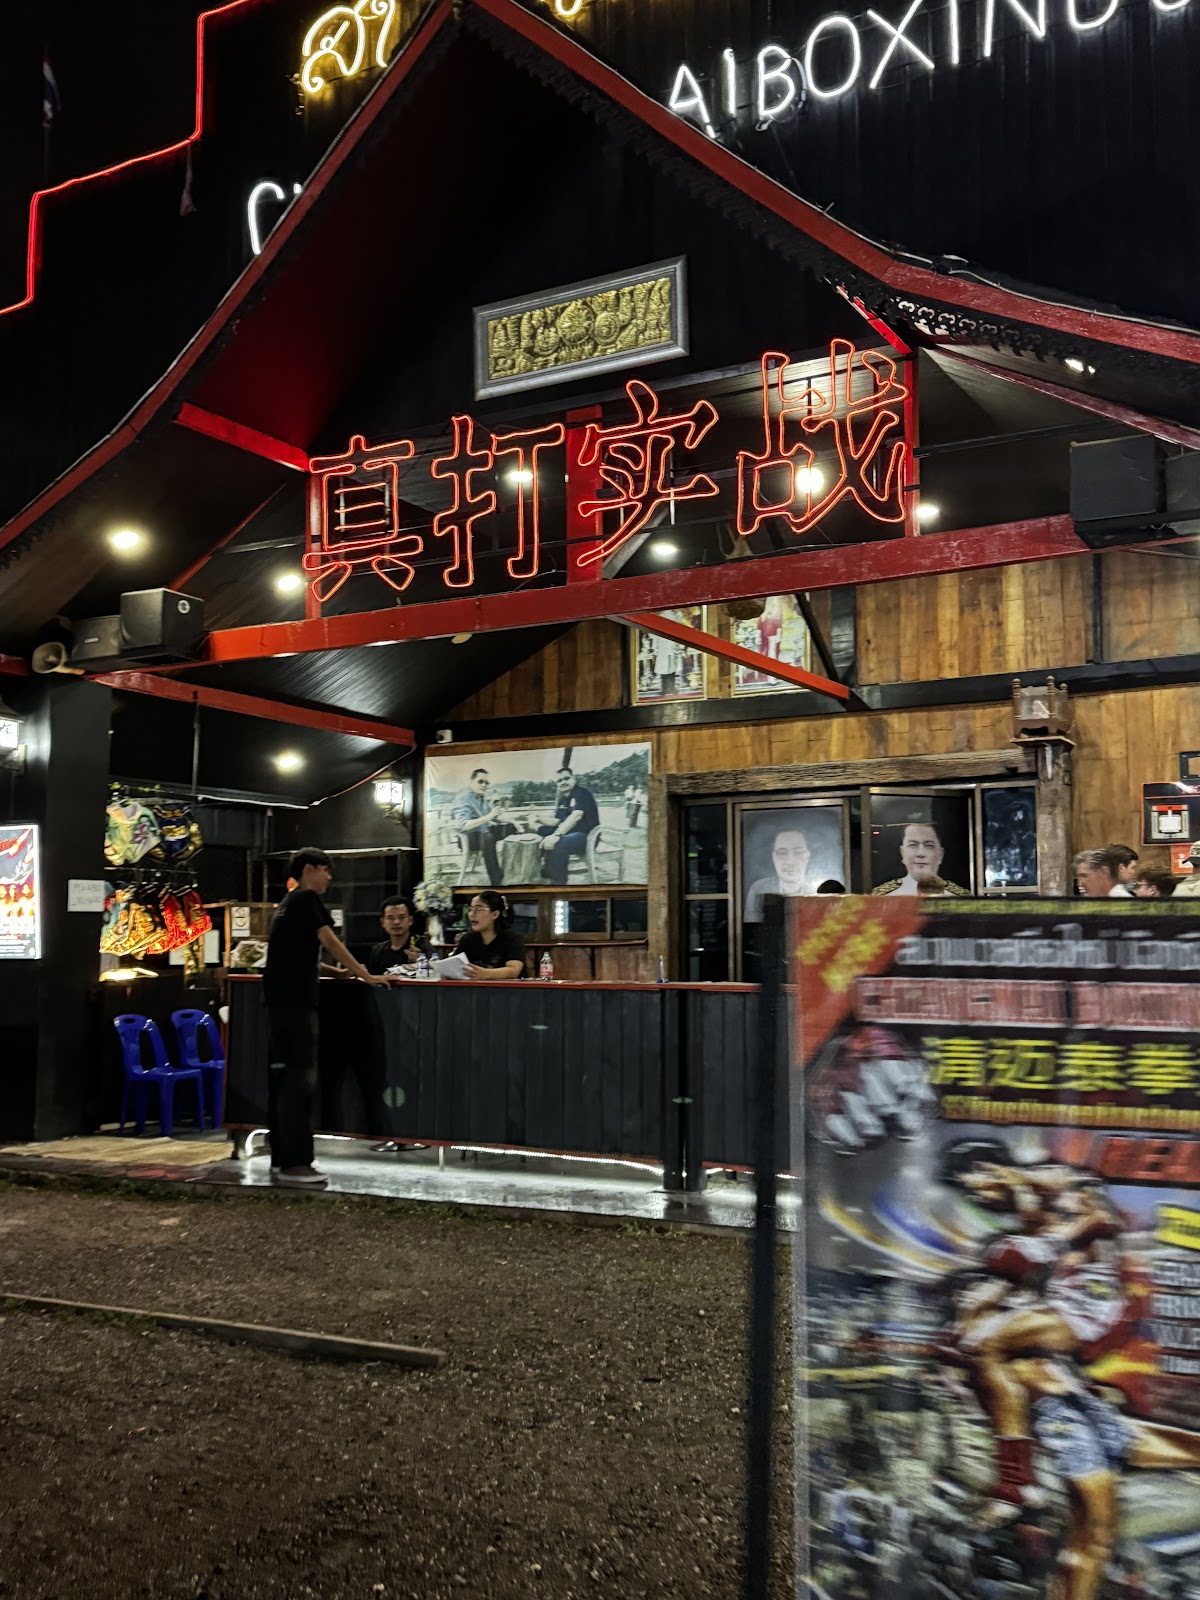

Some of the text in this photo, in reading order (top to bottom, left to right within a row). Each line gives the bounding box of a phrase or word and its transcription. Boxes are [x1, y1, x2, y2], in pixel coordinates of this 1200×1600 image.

[302, 338, 909, 602] 真打实战
[922, 1037, 1200, 1094] 清迈泰拳
